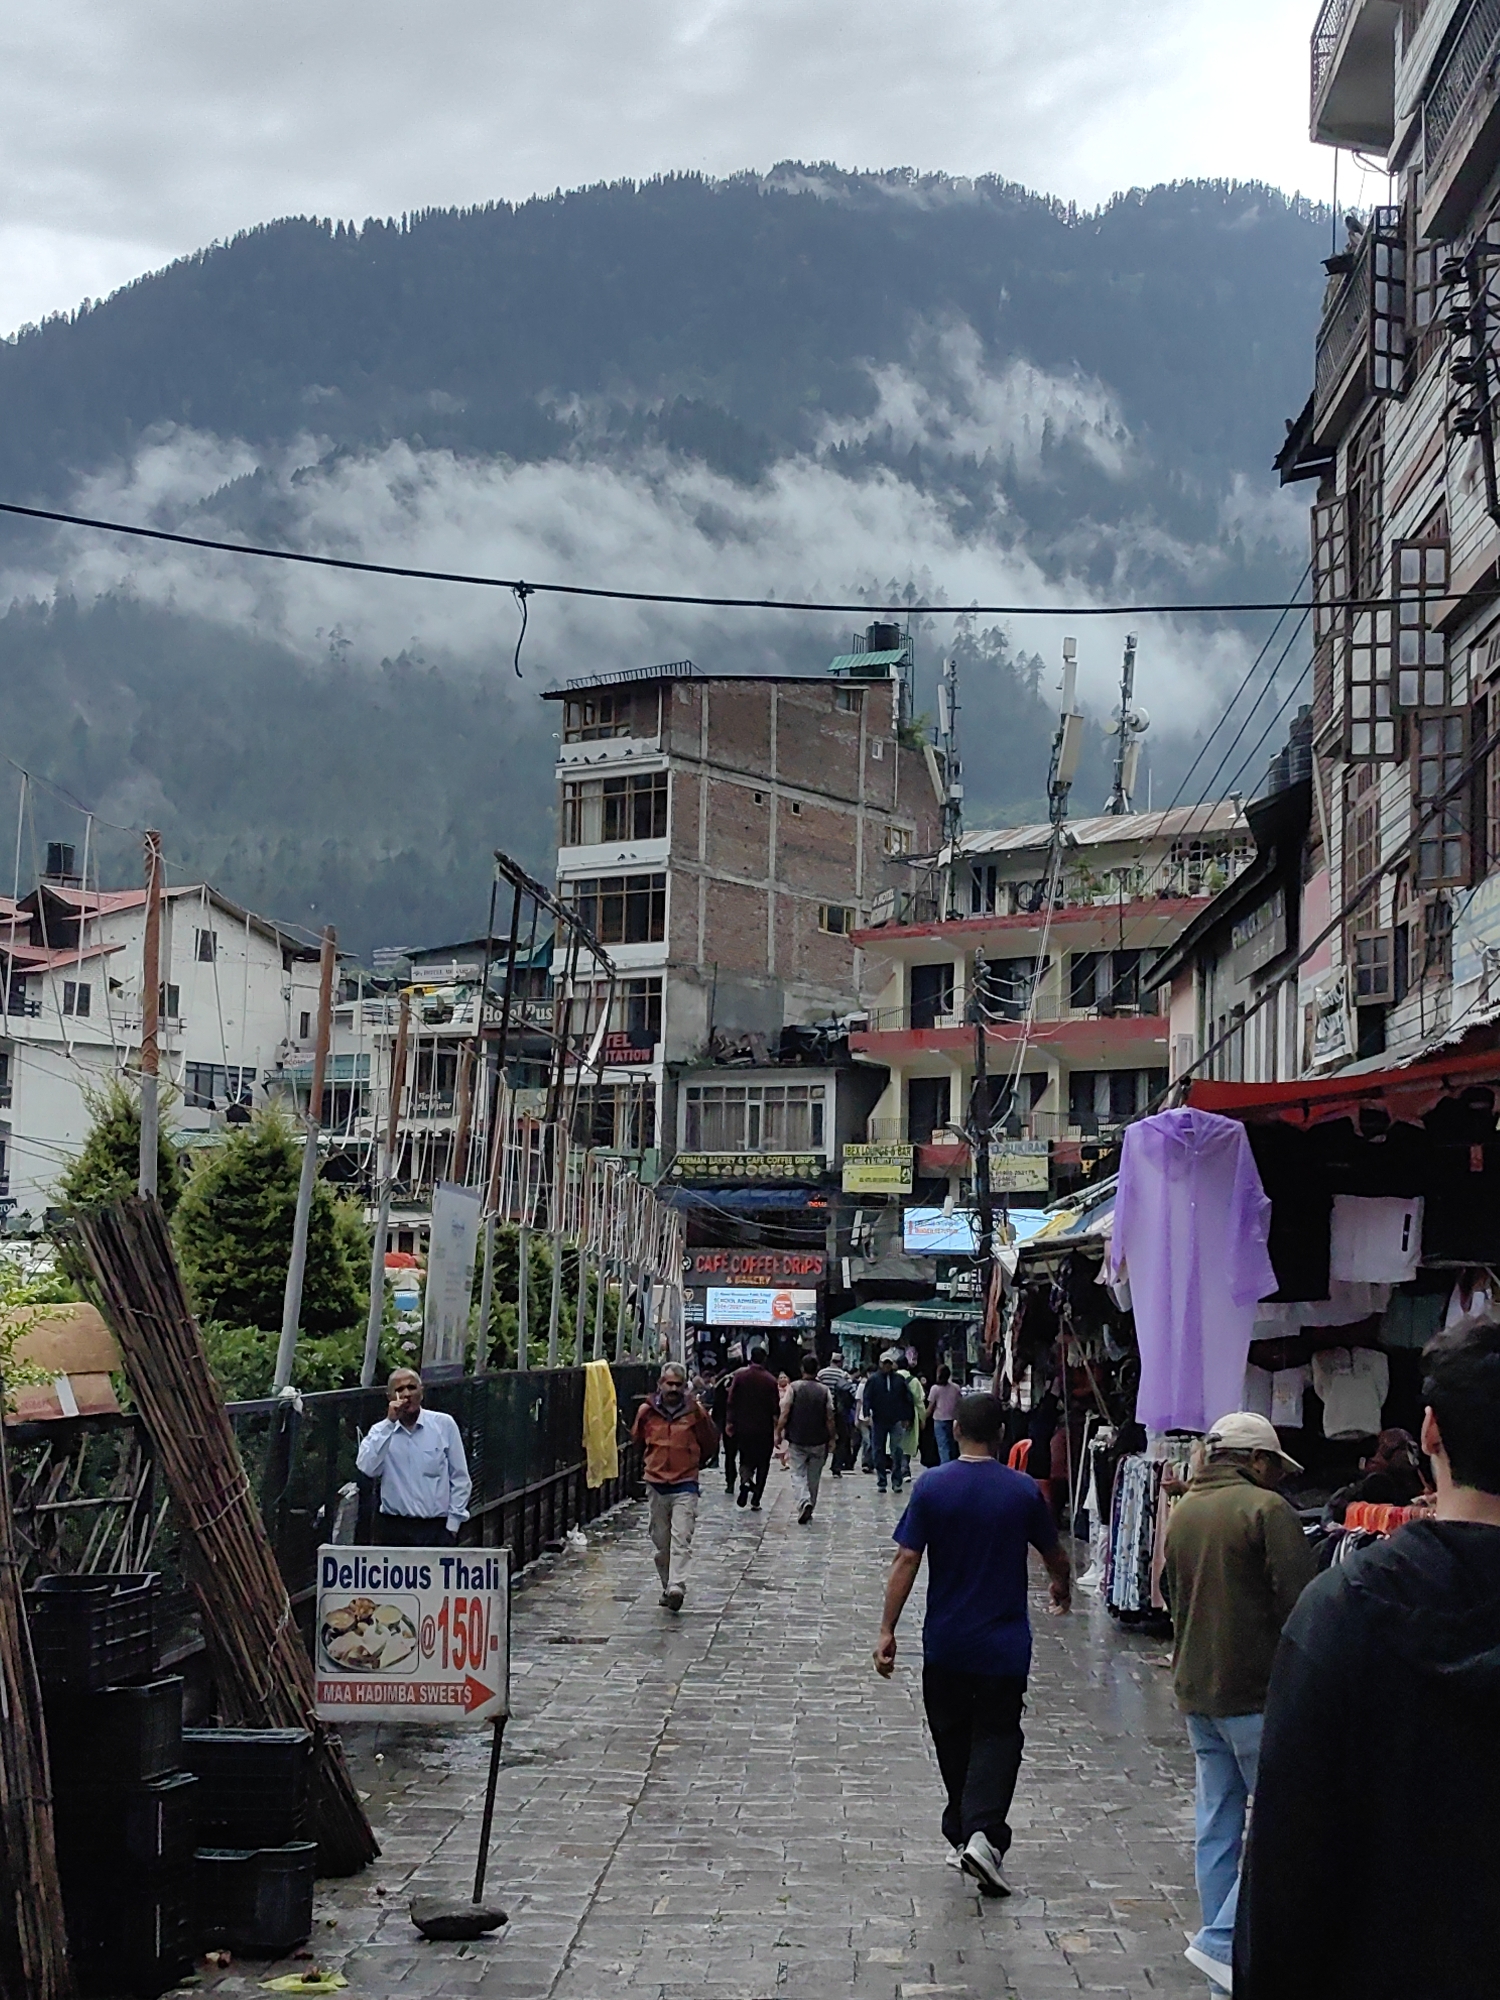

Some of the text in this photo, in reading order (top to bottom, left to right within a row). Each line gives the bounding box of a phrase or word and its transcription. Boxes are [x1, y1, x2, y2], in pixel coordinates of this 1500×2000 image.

[483, 1004, 554, 1021] Hoel Pus
[583, 1033, 631, 1051] HTEL
[677, 1155, 707, 1165] GERMAN
[709, 1155, 735, 1164] BAKERY
[767, 1155, 793, 1164] COFFEE
[795, 1155, 816, 1165] DRIPS
[731, 1255, 781, 1274] COFFEE
[734, 1275, 771, 1286] BAKERY
[322, 1556, 499, 1591] Delicious Thali
[323, 1684, 473, 1704] MAA HADIMBA SWEETS
